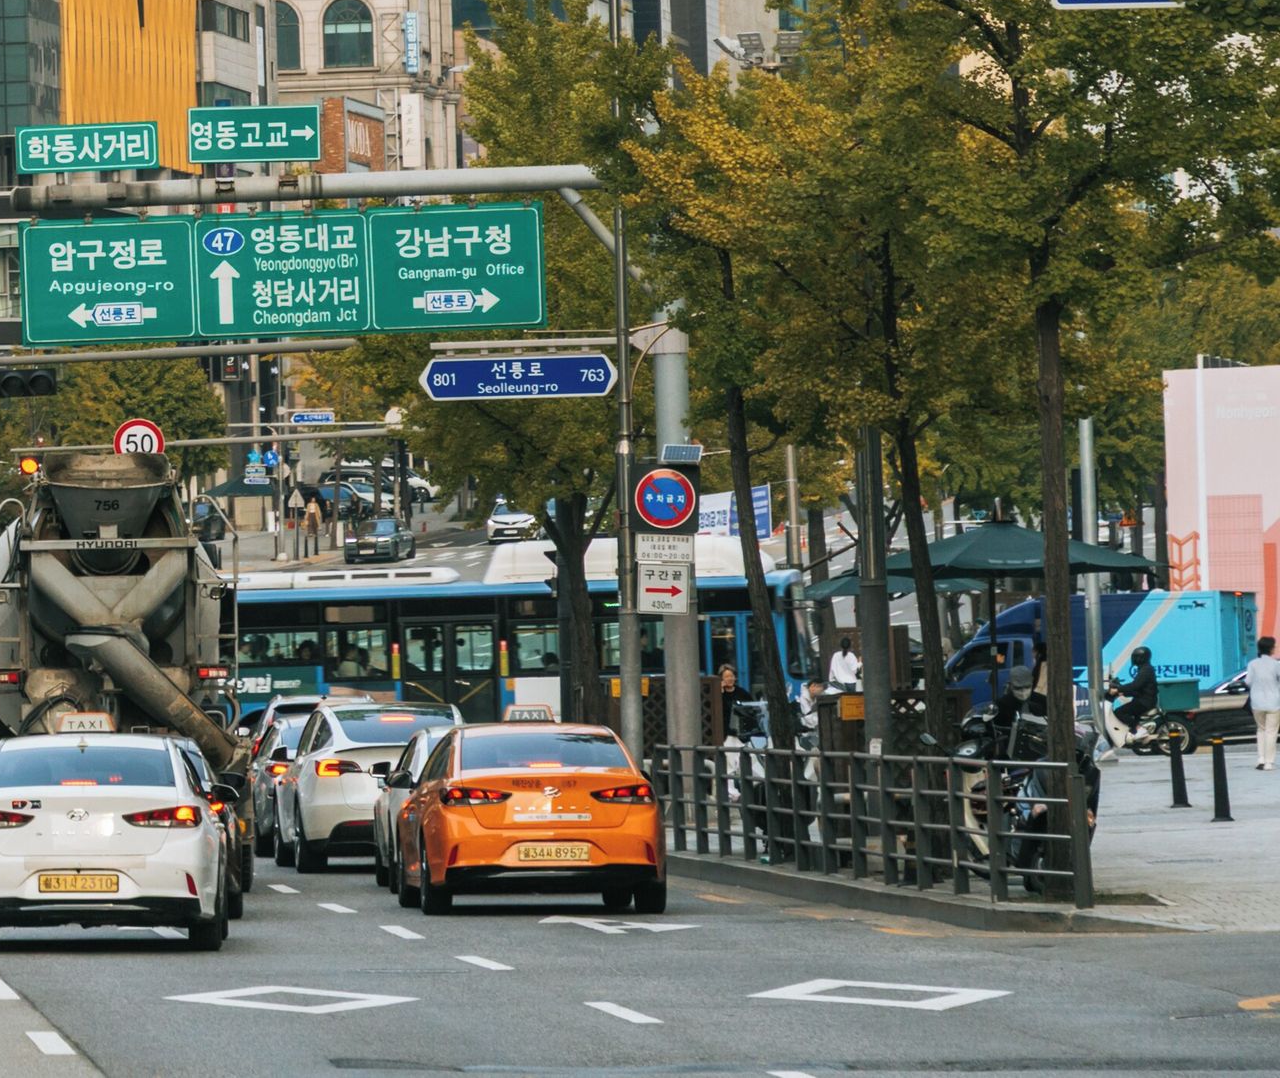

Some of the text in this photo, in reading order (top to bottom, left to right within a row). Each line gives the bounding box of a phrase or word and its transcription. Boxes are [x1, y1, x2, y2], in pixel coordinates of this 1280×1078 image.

[191, 120, 289, 151] 영동고교
[27, 129, 150, 165] 학동사거리
[211, 232, 234, 252] 47
[250, 223, 358, 255] 영동대교
[395, 224, 512, 258] 강남구청
[48, 238, 167, 272] 압구정로
[254, 253, 359, 275] Yeongdonggyo(Br)
[398, 263, 525, 281] Gangnam-gu Office
[48, 279, 175, 296] Apgujeong-ro
[252, 276, 361, 308] 청담사거리
[430, 292, 469, 308] 선릉로
[99, 307, 138, 322] 선릉로
[252, 307, 358, 327] Cheongdam Jct
[490, 361, 545, 380] 선릉로
[579, 368, 606, 383] 763
[432, 372, 457, 387] 801
[477, 381, 559, 395] Seolleung-ro
[125, 433, 154, 453] 50
[94, 499, 121, 512] 756
[645, 493, 685, 504] 주차금지
[75, 540, 139, 550] HYUNDAI
[650, 600, 673, 610] 430m
[513, 710, 546, 720] TAXI
[67, 719, 104, 730] TAXI
[555, 847, 585, 859] 8957
[80, 876, 114, 891] 2310
